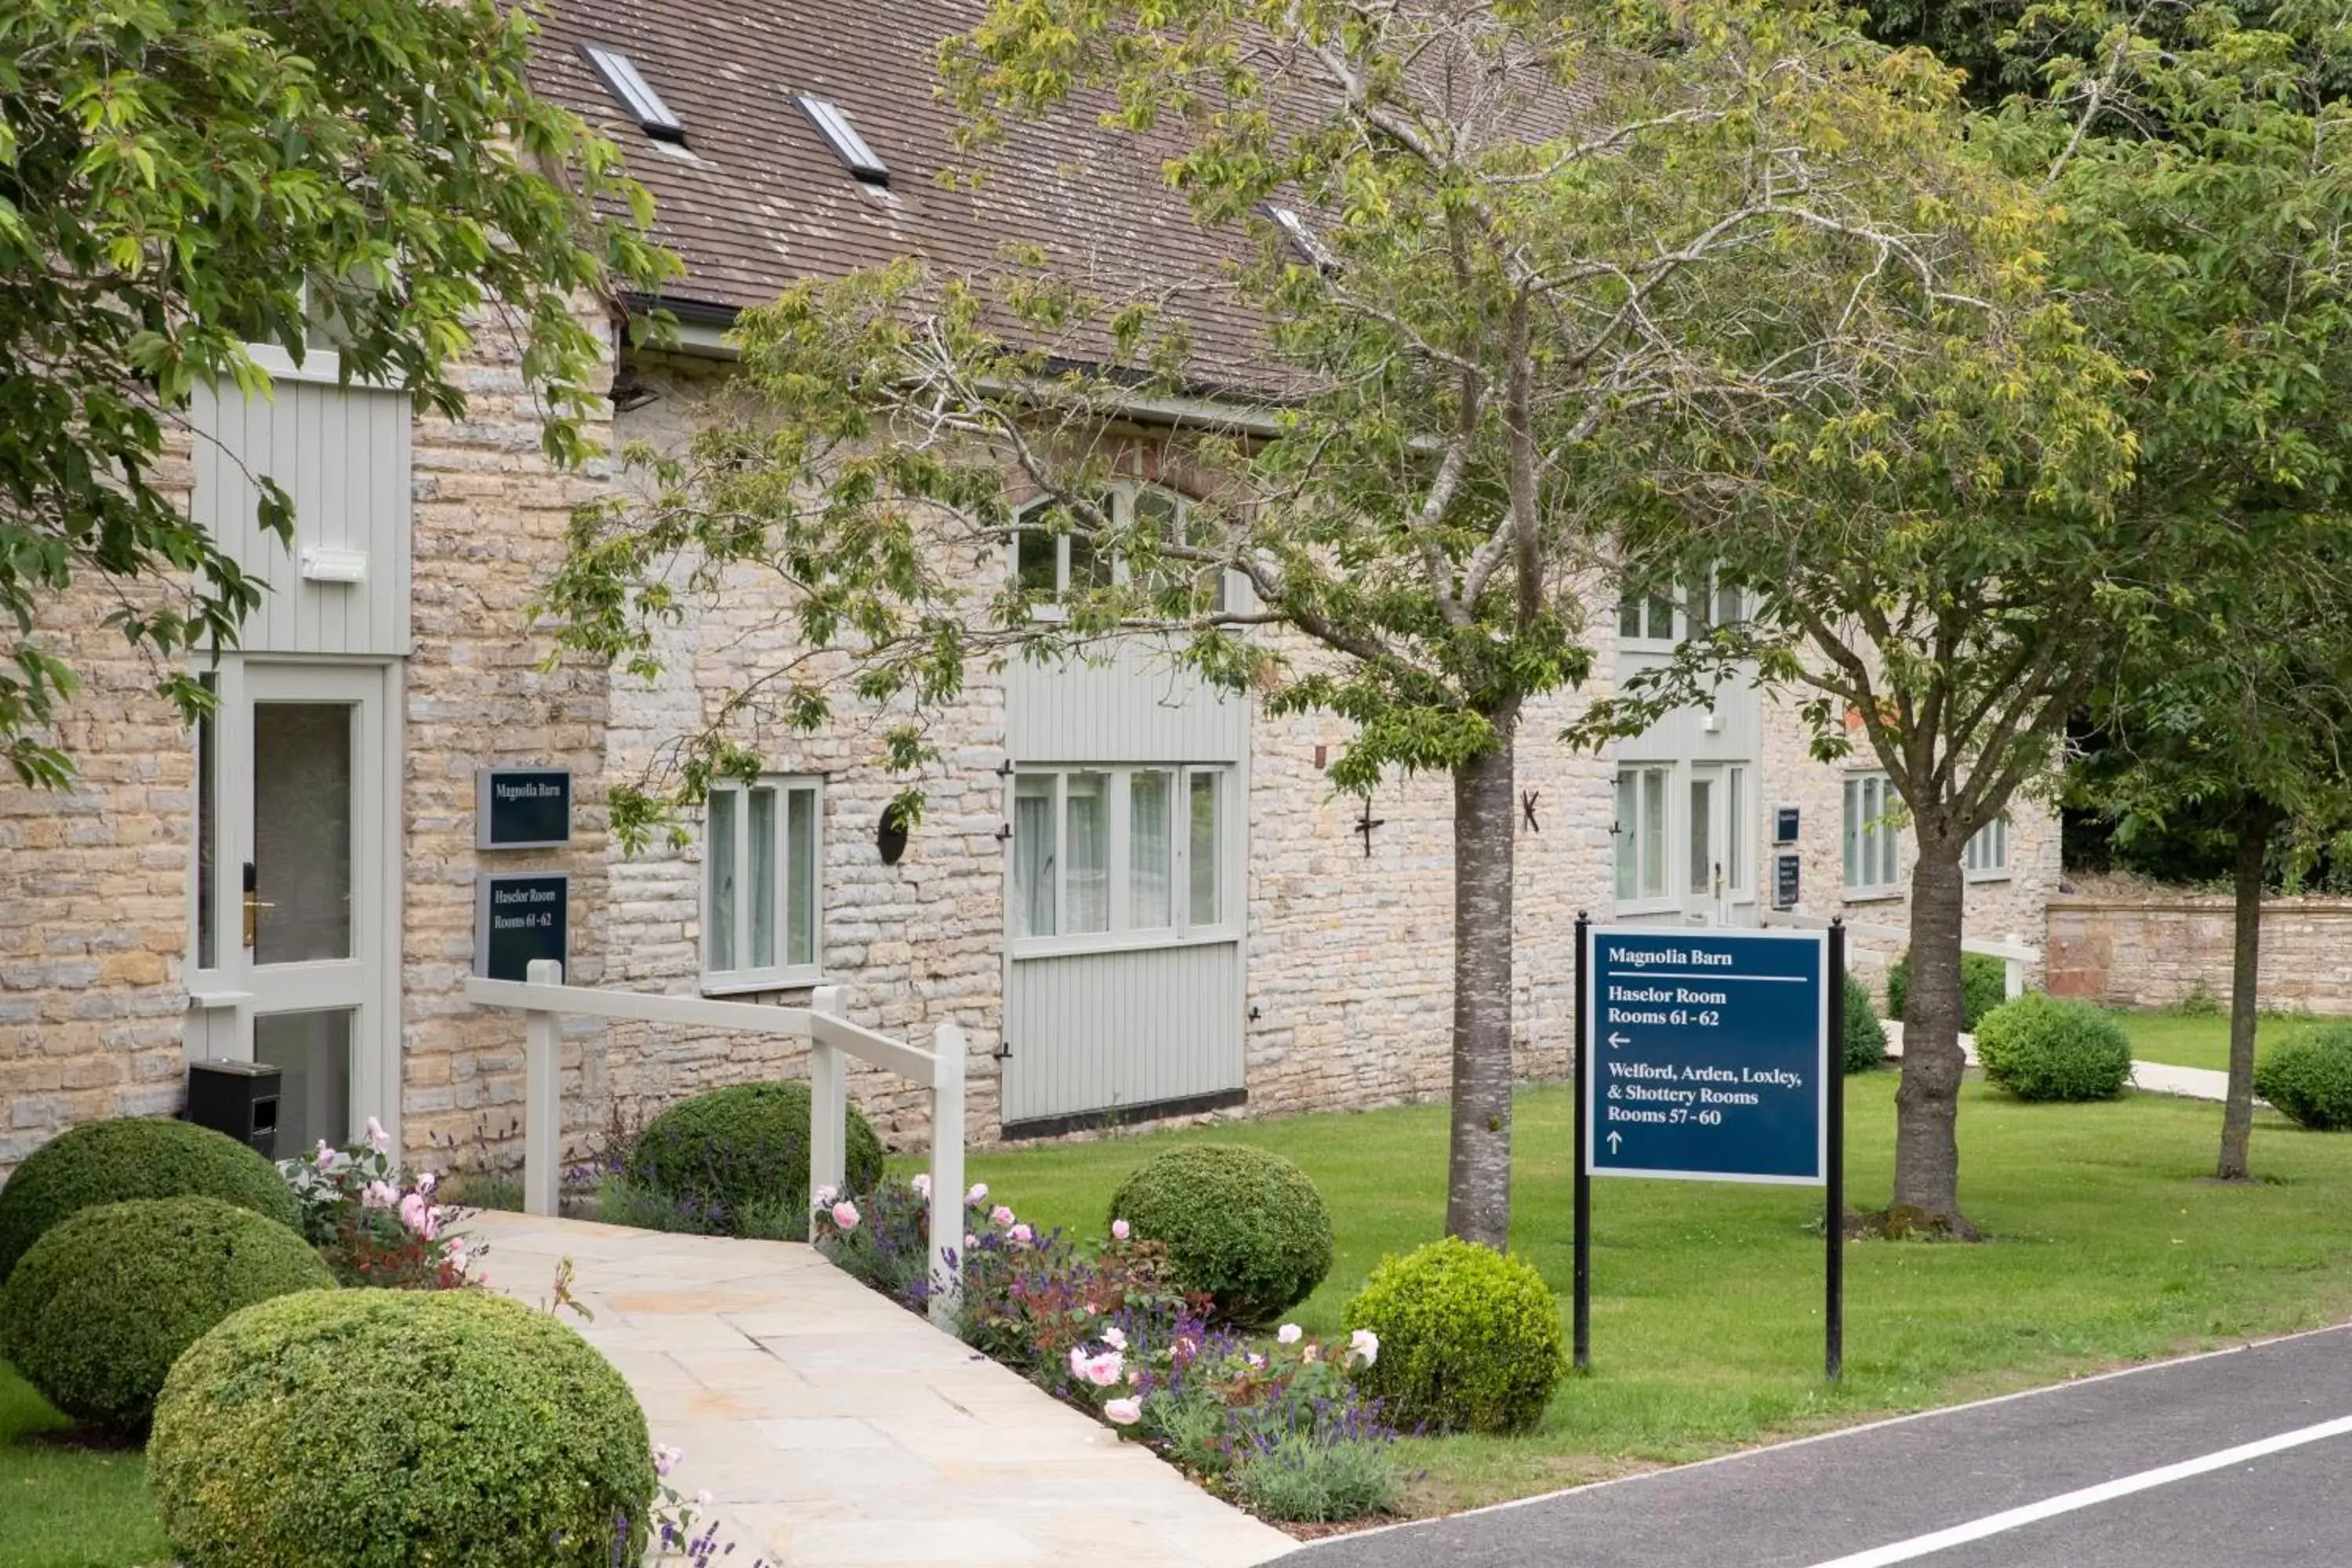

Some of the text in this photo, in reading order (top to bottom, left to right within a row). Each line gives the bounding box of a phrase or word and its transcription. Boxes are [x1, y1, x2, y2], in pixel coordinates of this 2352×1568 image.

[1609, 947, 1733, 967] Magnolia Barn
[1608, 985, 1726, 1004] Haselor Room
[1608, 1007, 1667, 1025] Rooms
[1608, 1062, 1802, 1089] Welford, Arden, Loxley,
[1606, 1084, 1759, 1106] & Shottery Rooms
[1608, 1105, 1667, 1123] Rooms
